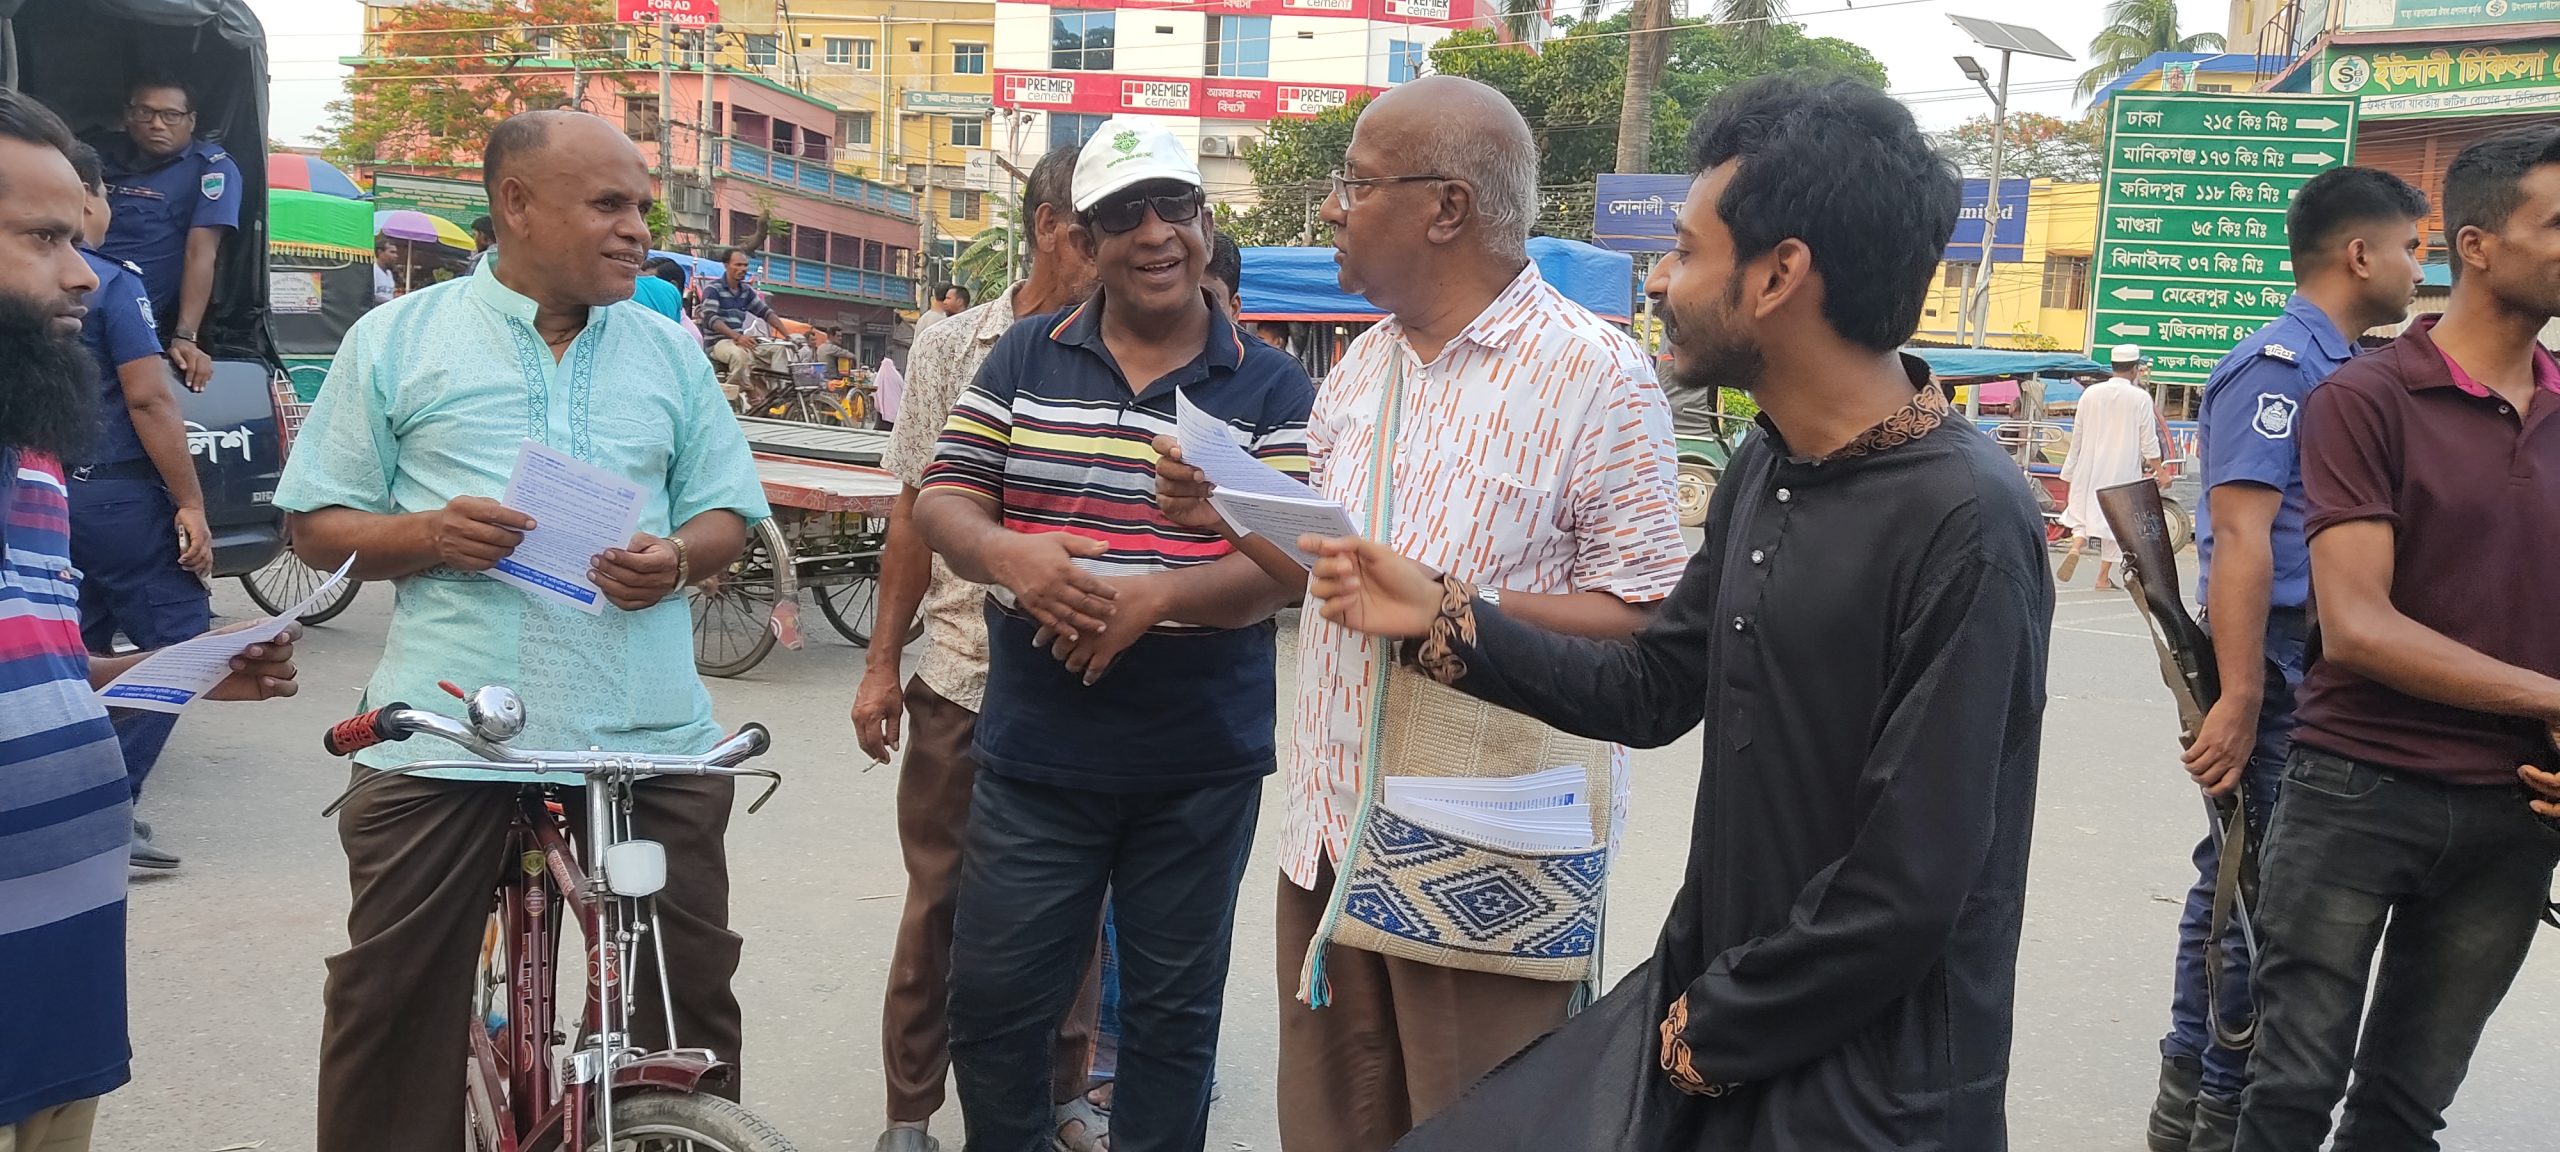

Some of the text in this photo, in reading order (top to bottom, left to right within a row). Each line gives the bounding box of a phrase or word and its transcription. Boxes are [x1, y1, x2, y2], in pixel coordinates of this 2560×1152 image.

[647, 0, 690, 10] FOR AD
[1407, 6, 1448, 18] cement
[2372, 48, 2455, 92] ইউনানী
[2456, 47, 2549, 84] চিকিৎসা
[1027, 77, 1073, 93] PREMIER
[1144, 83, 1189, 98] PREMIER
[1206, 87, 1235, 98] আমরা
[1027, 92, 1070, 102] cement
[1144, 97, 1188, 108] cement
[1300, 88, 1345, 104] PREMIER
[2408, 95, 2440, 109] যাবতীয়
[2443, 94, 2467, 106] জটিল
[1217, 99, 1246, 113] বিশ্বাসী
[2126, 109, 2288, 132] ঢাকা ২১৫ কিঃ মিঃ
[2122, 143, 2285, 168] মানিকগঞ্জ ১৭৩ কিঃ মিঃ
[2119, 177, 2279, 203] ফরিদপুর ১১৮ কিঃ মিঃ
[1609, 195, 1662, 215] সোনালী
[2115, 214, 2267, 239] মাগুরা ৬৫ কিঃ মিঃ
[2111, 247, 2264, 274] ঝিনাইদহ ৩৭ কিঃ মিঃ
[2161, 287, 2287, 309] মেহেরপুর ২৬ কিঃ
[2157, 318, 2229, 341] মুজিবনগর
[2157, 355, 2187, 368] সড়ক
